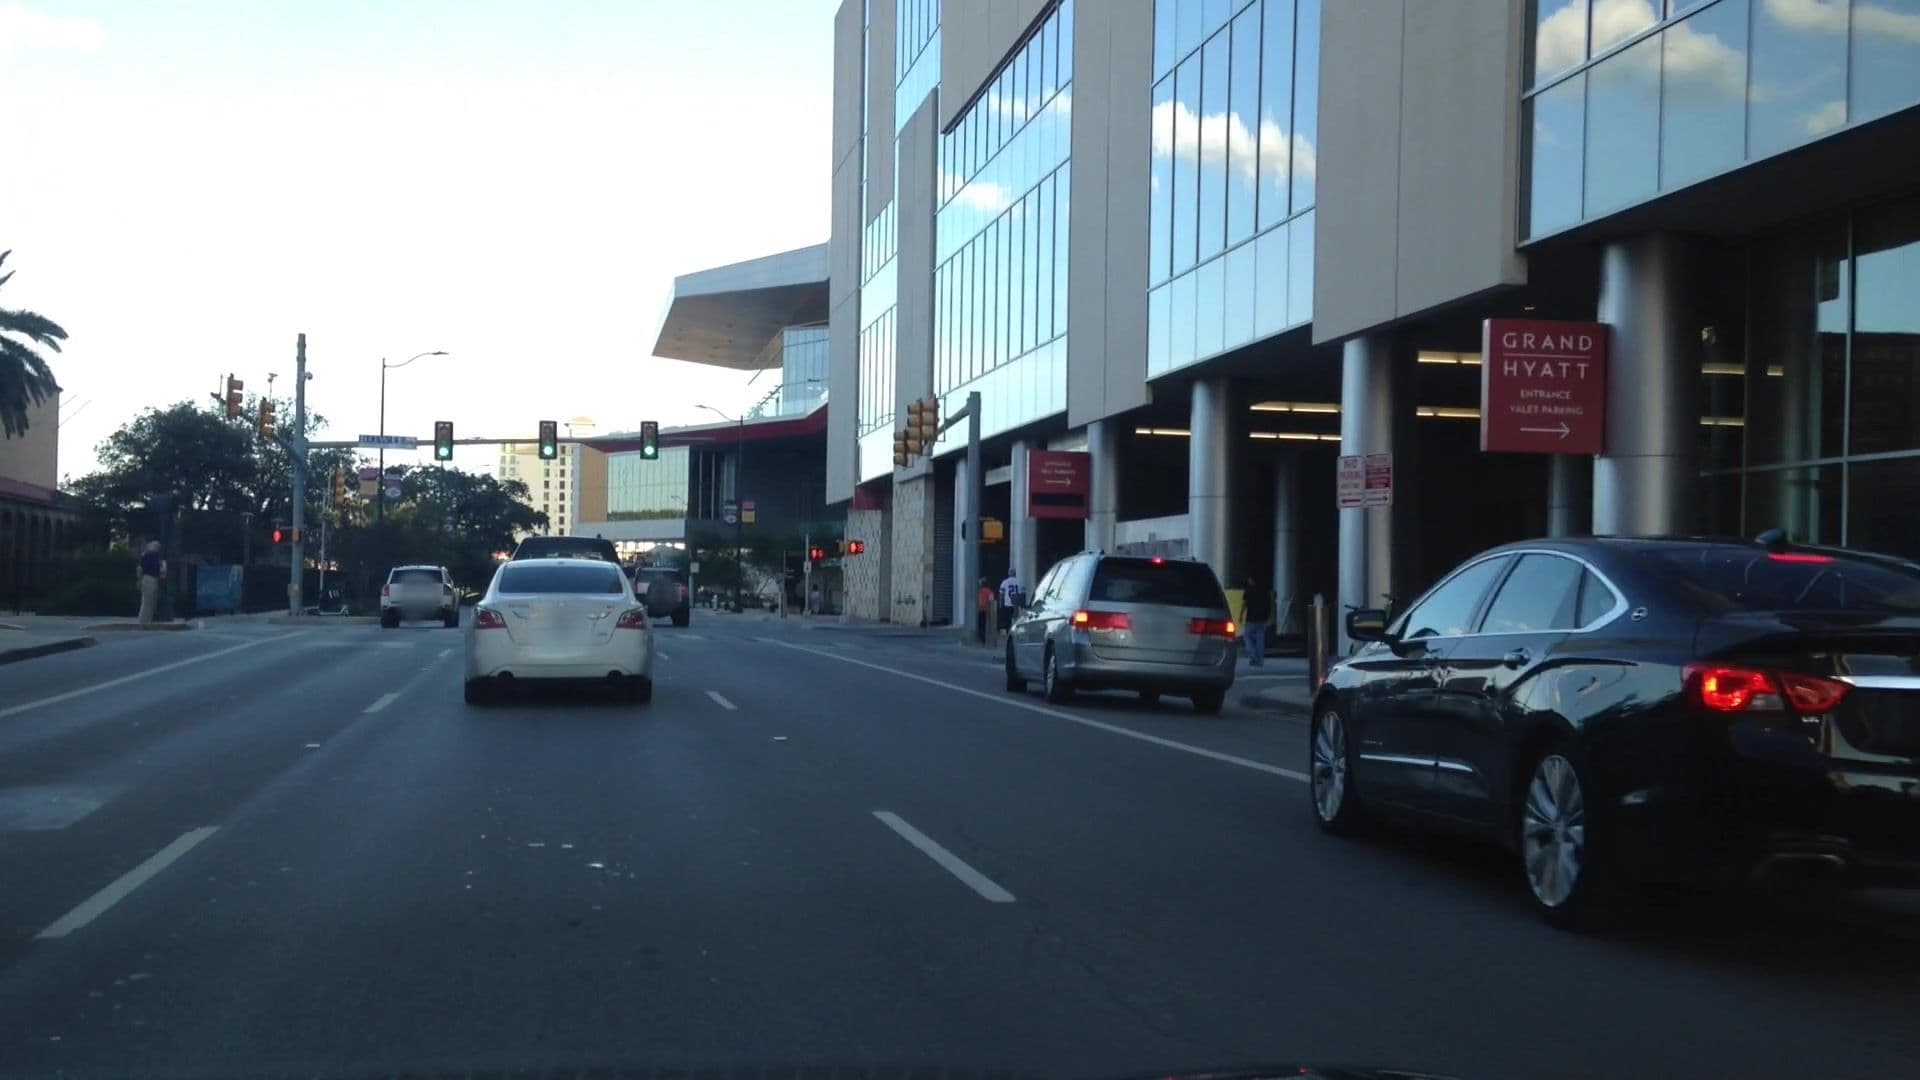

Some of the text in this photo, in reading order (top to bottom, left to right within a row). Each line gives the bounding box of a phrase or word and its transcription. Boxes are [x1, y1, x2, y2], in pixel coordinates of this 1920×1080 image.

[1502, 332, 1593, 351] GRAND
[1503, 360, 1590, 379] HYATT
[1520, 389, 1572, 400] ENTRANCE
[1542, 405, 1583, 416] PARKING
